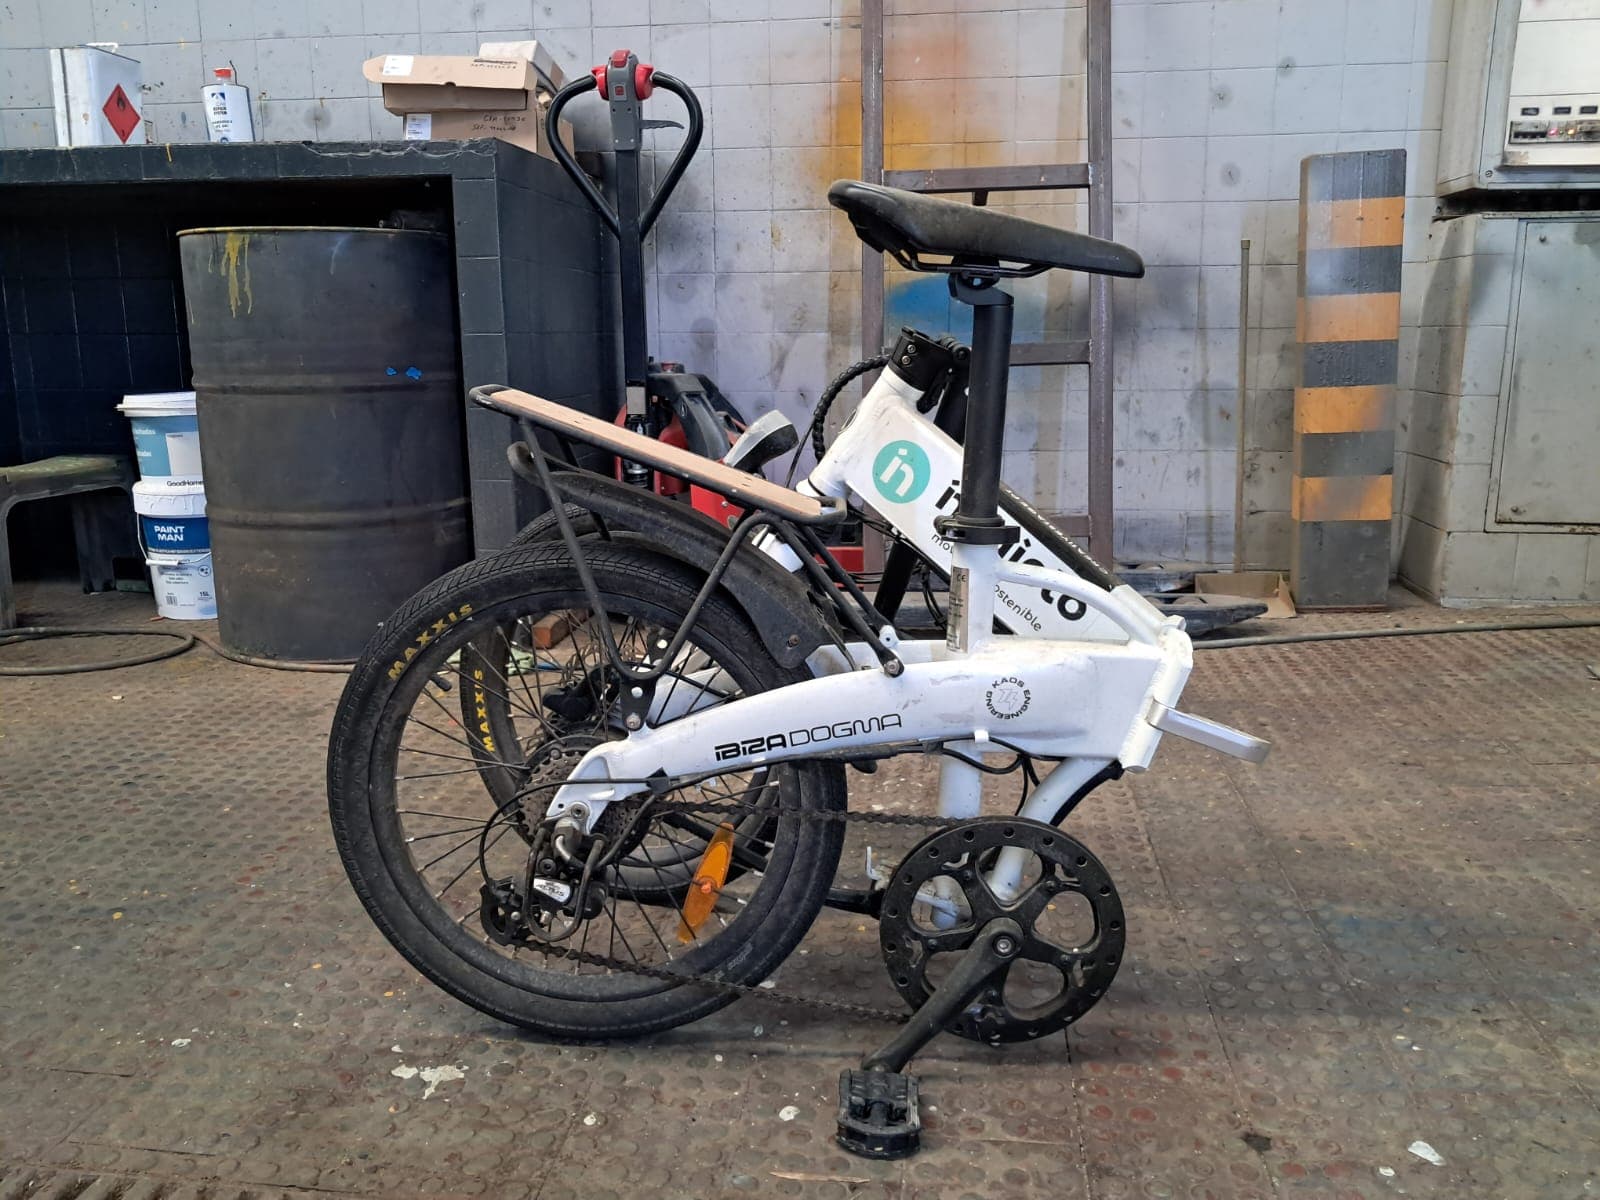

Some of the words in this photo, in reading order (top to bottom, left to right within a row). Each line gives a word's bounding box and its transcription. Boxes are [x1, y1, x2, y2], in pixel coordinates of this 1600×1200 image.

[154, 525, 185, 533] PAINT
[993, 584, 1042, 632] ostenible
[388, 604, 473, 681] MAXXIS
[992, 677, 1025, 689] KAOS
[474, 669, 496, 752] MAXXIS
[714, 733, 787, 762] IBIZA
[789, 713, 902, 747] DOGMA
